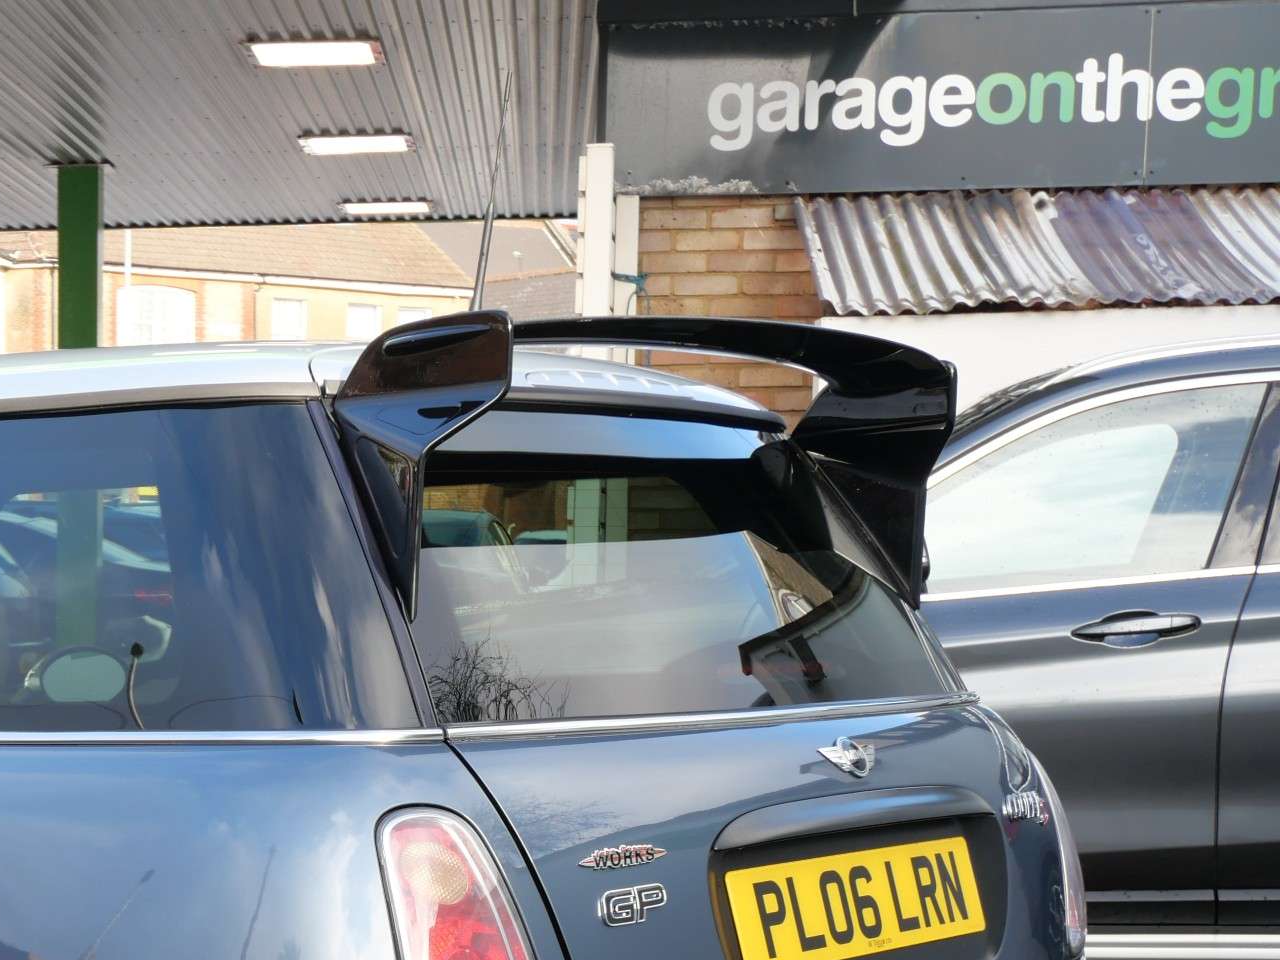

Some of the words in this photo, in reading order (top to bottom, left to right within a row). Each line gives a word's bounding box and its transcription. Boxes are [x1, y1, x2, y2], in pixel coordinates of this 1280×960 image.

[593, 846, 655, 868] WORKS
[601, 882, 667, 927] GP
[752, 865, 883, 959] PL06
[884, 850, 969, 933] LRN
